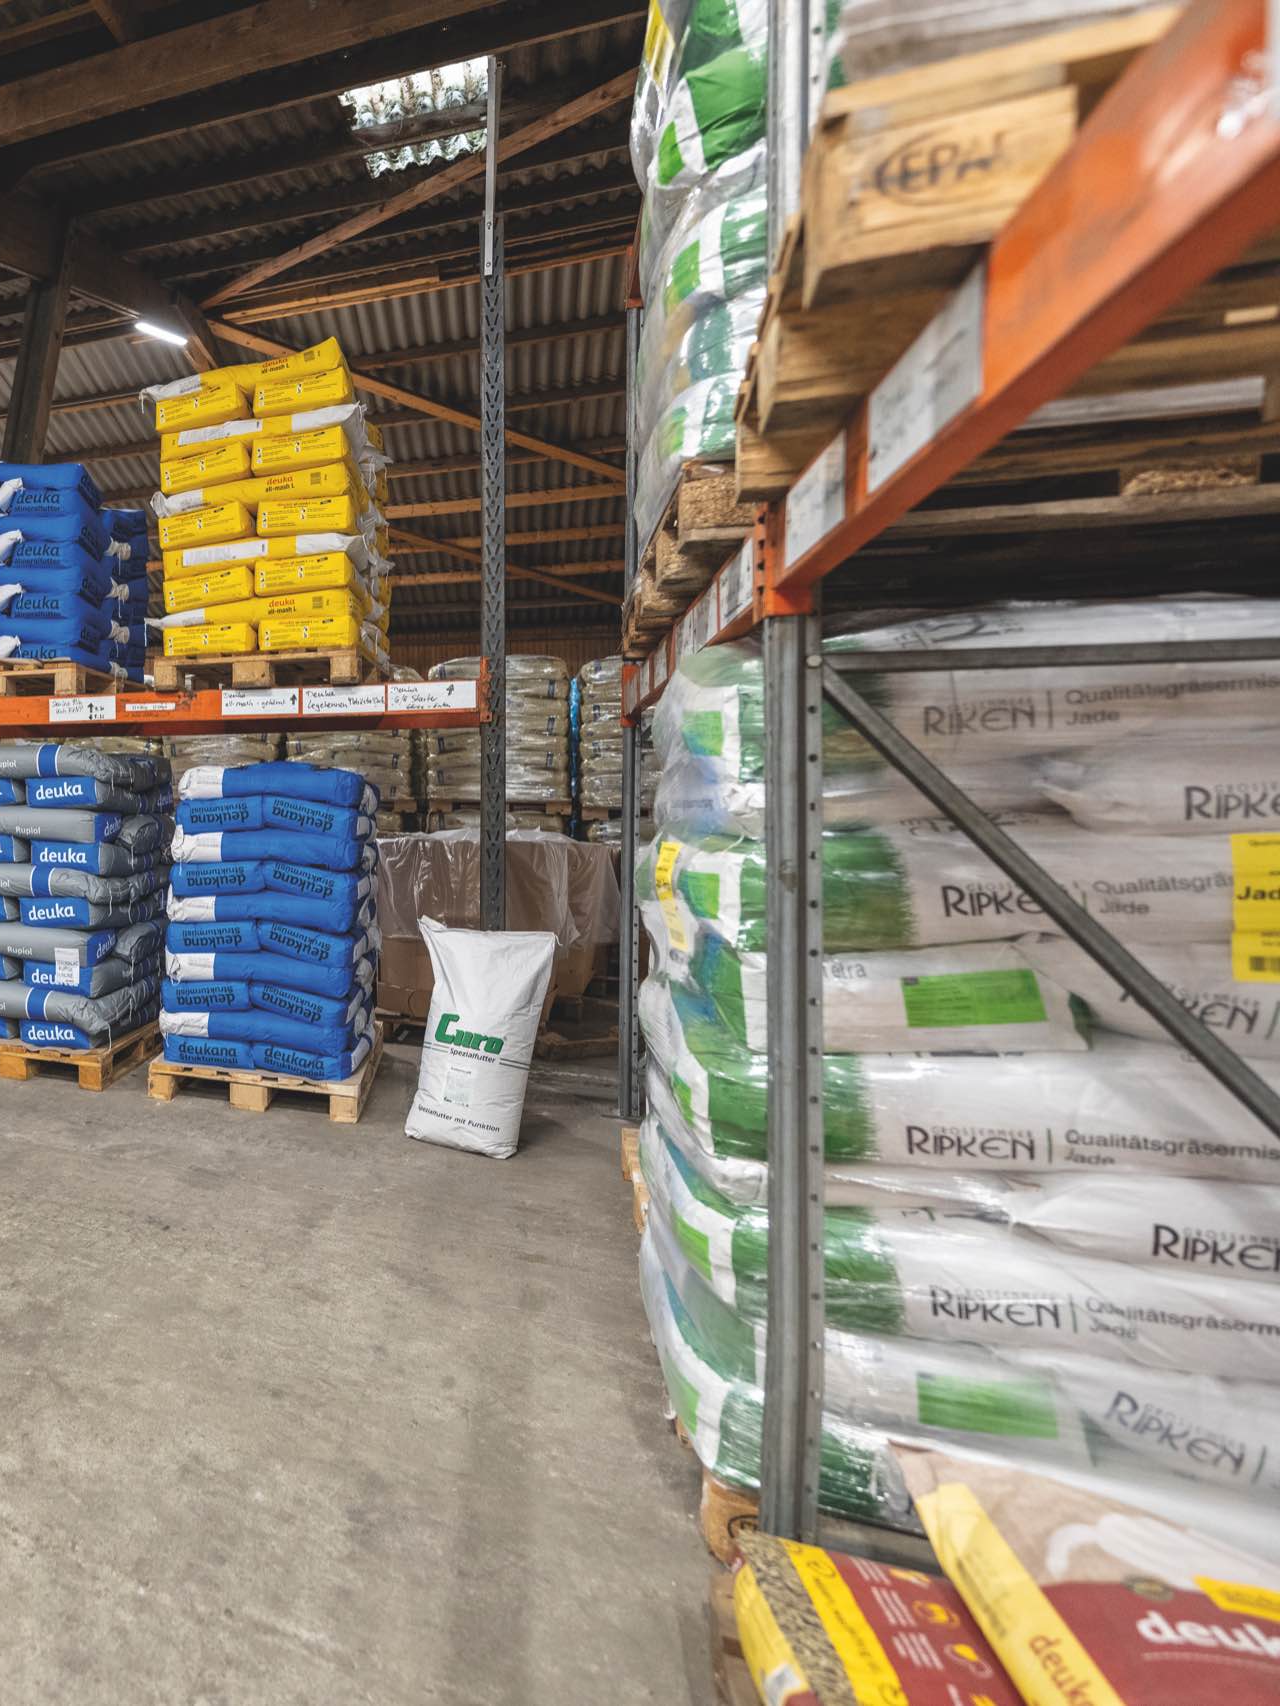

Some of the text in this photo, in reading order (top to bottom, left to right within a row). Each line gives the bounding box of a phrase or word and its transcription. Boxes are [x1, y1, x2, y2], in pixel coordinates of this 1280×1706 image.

[265, 484, 290, 493] all-mash
[267, 476, 293, 486] deuka
[16, 489, 60, 504] deuka
[16, 544, 60, 556] deuka
[15, 595, 59, 610] deuka
[268, 606, 292, 615] all-mash
[269, 598, 295, 608] deuka
[1066, 710, 1120, 726] Jade
[35, 783, 84, 801] deuka
[190, 809, 250, 824] deukana
[272, 807, 334, 832] deukana
[15, 825, 41, 836] Rupiol
[39, 848, 87, 865] deuka
[186, 873, 247, 887] deukana
[272, 870, 334, 898] deukana
[941, 885, 1050, 918] RIPKE
[1091, 873, 1234, 895] Qualitätsgrä
[28, 904, 75, 921] deuka
[183, 934, 243, 948] deukana
[269, 931, 330, 962] deukana
[7, 946, 33, 956] Rupiol
[176, 993, 236, 1006] deukana
[262, 992, 321, 1022] deukana
[27, 1025, 75, 1041] deuka
[435, 1013, 504, 1055] Curo
[178, 1043, 237, 1058] deukana
[264, 1047, 325, 1070] deukana
[450, 1048, 496, 1063] Spezialfutter
[454, 1117, 466, 1125] mit
[468, 1120, 500, 1133] Funktion
[905, 1125, 1036, 1161] RIPKEN
[1065, 1151, 1116, 1167] Jade
[929, 1285, 1060, 1329] RIPKEN
[1103, 1390, 1246, 1476] RIPKEN
